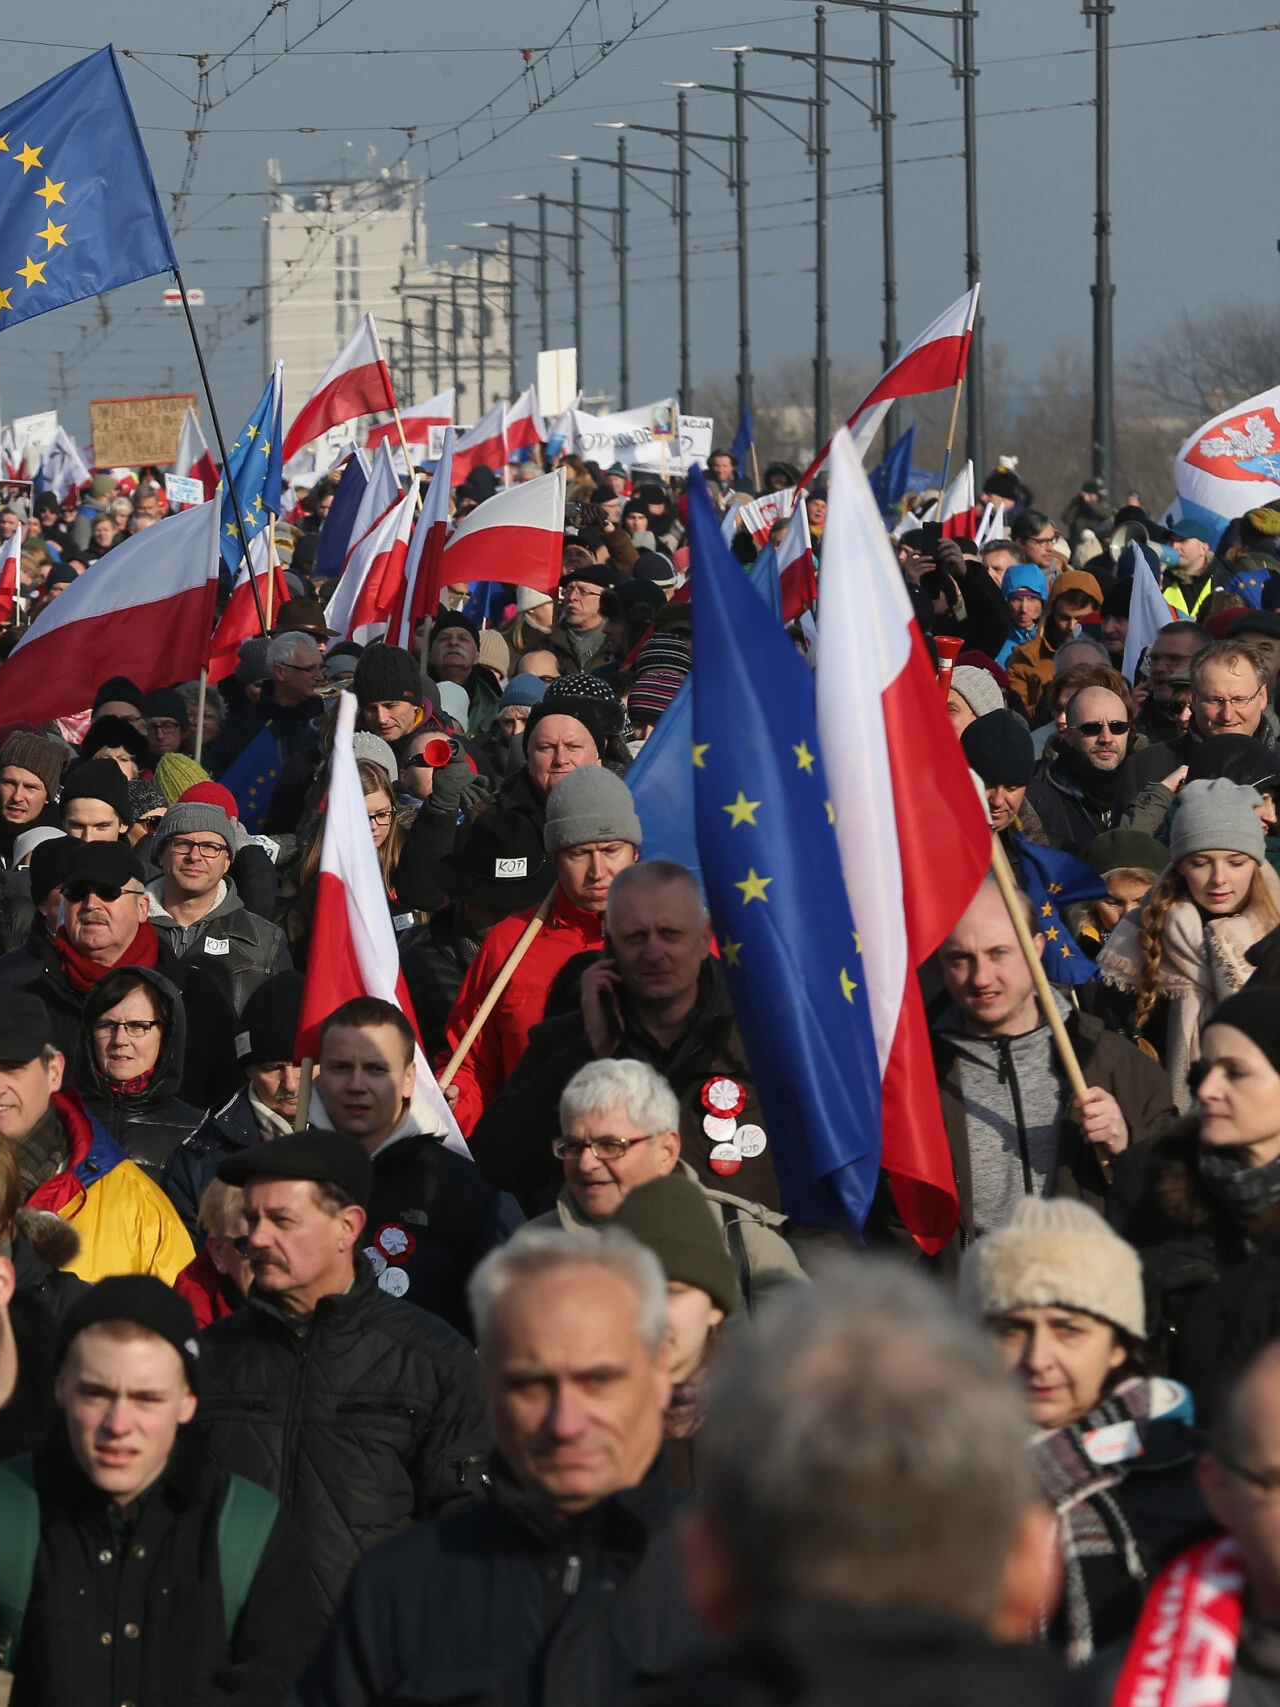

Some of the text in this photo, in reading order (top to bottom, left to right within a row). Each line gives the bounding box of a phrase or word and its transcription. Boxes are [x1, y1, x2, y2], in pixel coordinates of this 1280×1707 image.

[499, 859, 525, 872] KOD
[206, 939, 227, 950] KOD
[741, 1144, 759, 1153] KOD
